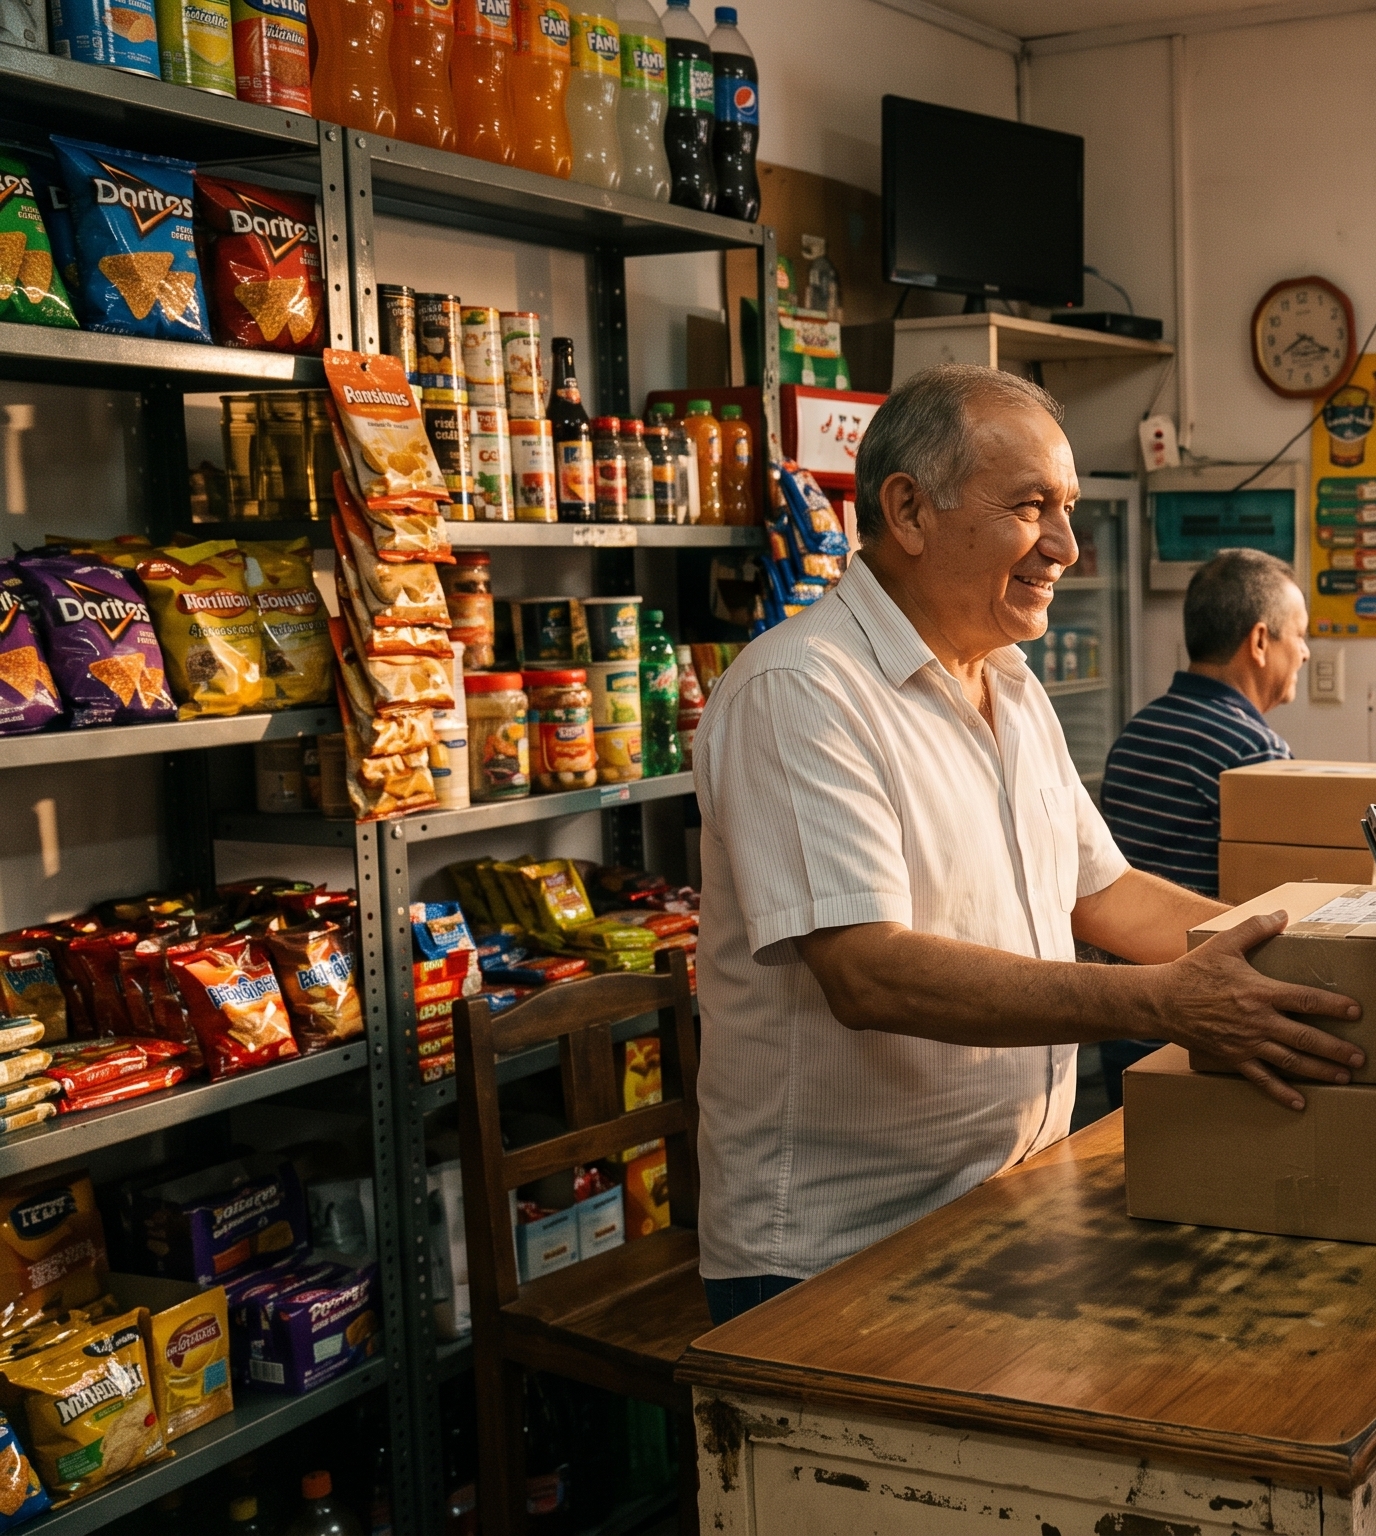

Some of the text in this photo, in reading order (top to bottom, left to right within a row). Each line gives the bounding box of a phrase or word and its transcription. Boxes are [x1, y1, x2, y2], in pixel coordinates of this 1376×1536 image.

[93, 178, 194, 218] Doritos
[229, 209, 319, 244] Doritos
[1337, 328, 1345, 340] 3
[1332, 348, 1340, 359] 4
[1273, 355, 1282, 367] 8
[1286, 368, 1294, 380] 7
[1322, 365, 1331, 378] 5
[1304, 372, 1313, 384] 6
[57, 597, 151, 623] Doritos
